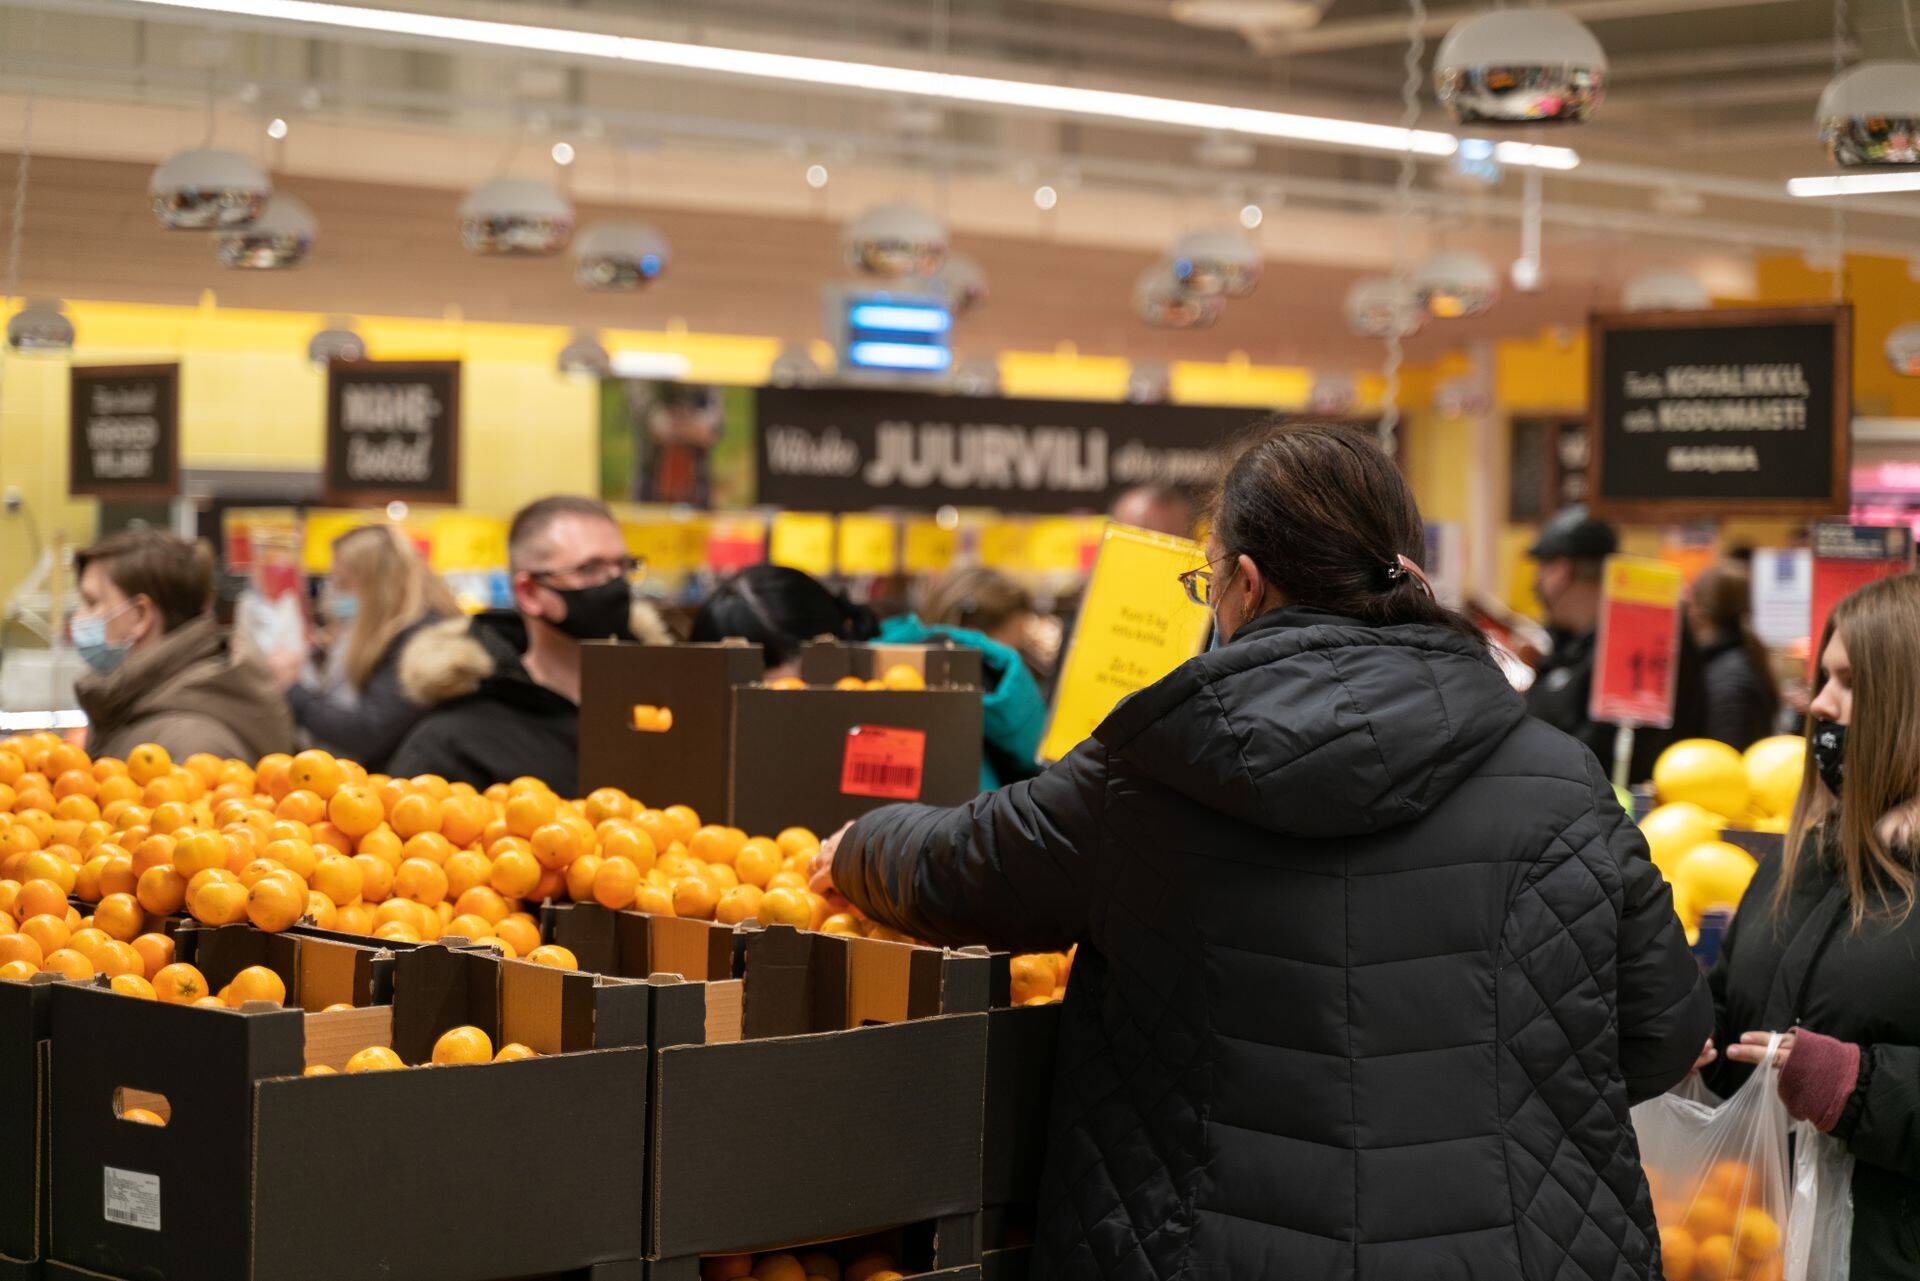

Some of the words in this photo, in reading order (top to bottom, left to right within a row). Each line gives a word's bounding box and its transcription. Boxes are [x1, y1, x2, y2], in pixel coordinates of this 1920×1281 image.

[1665, 363, 1809, 398] KOHALIKKU,
[1657, 399, 1807, 431] KODUMAIST!
[863, 420, 1108, 490] JUURVILI
